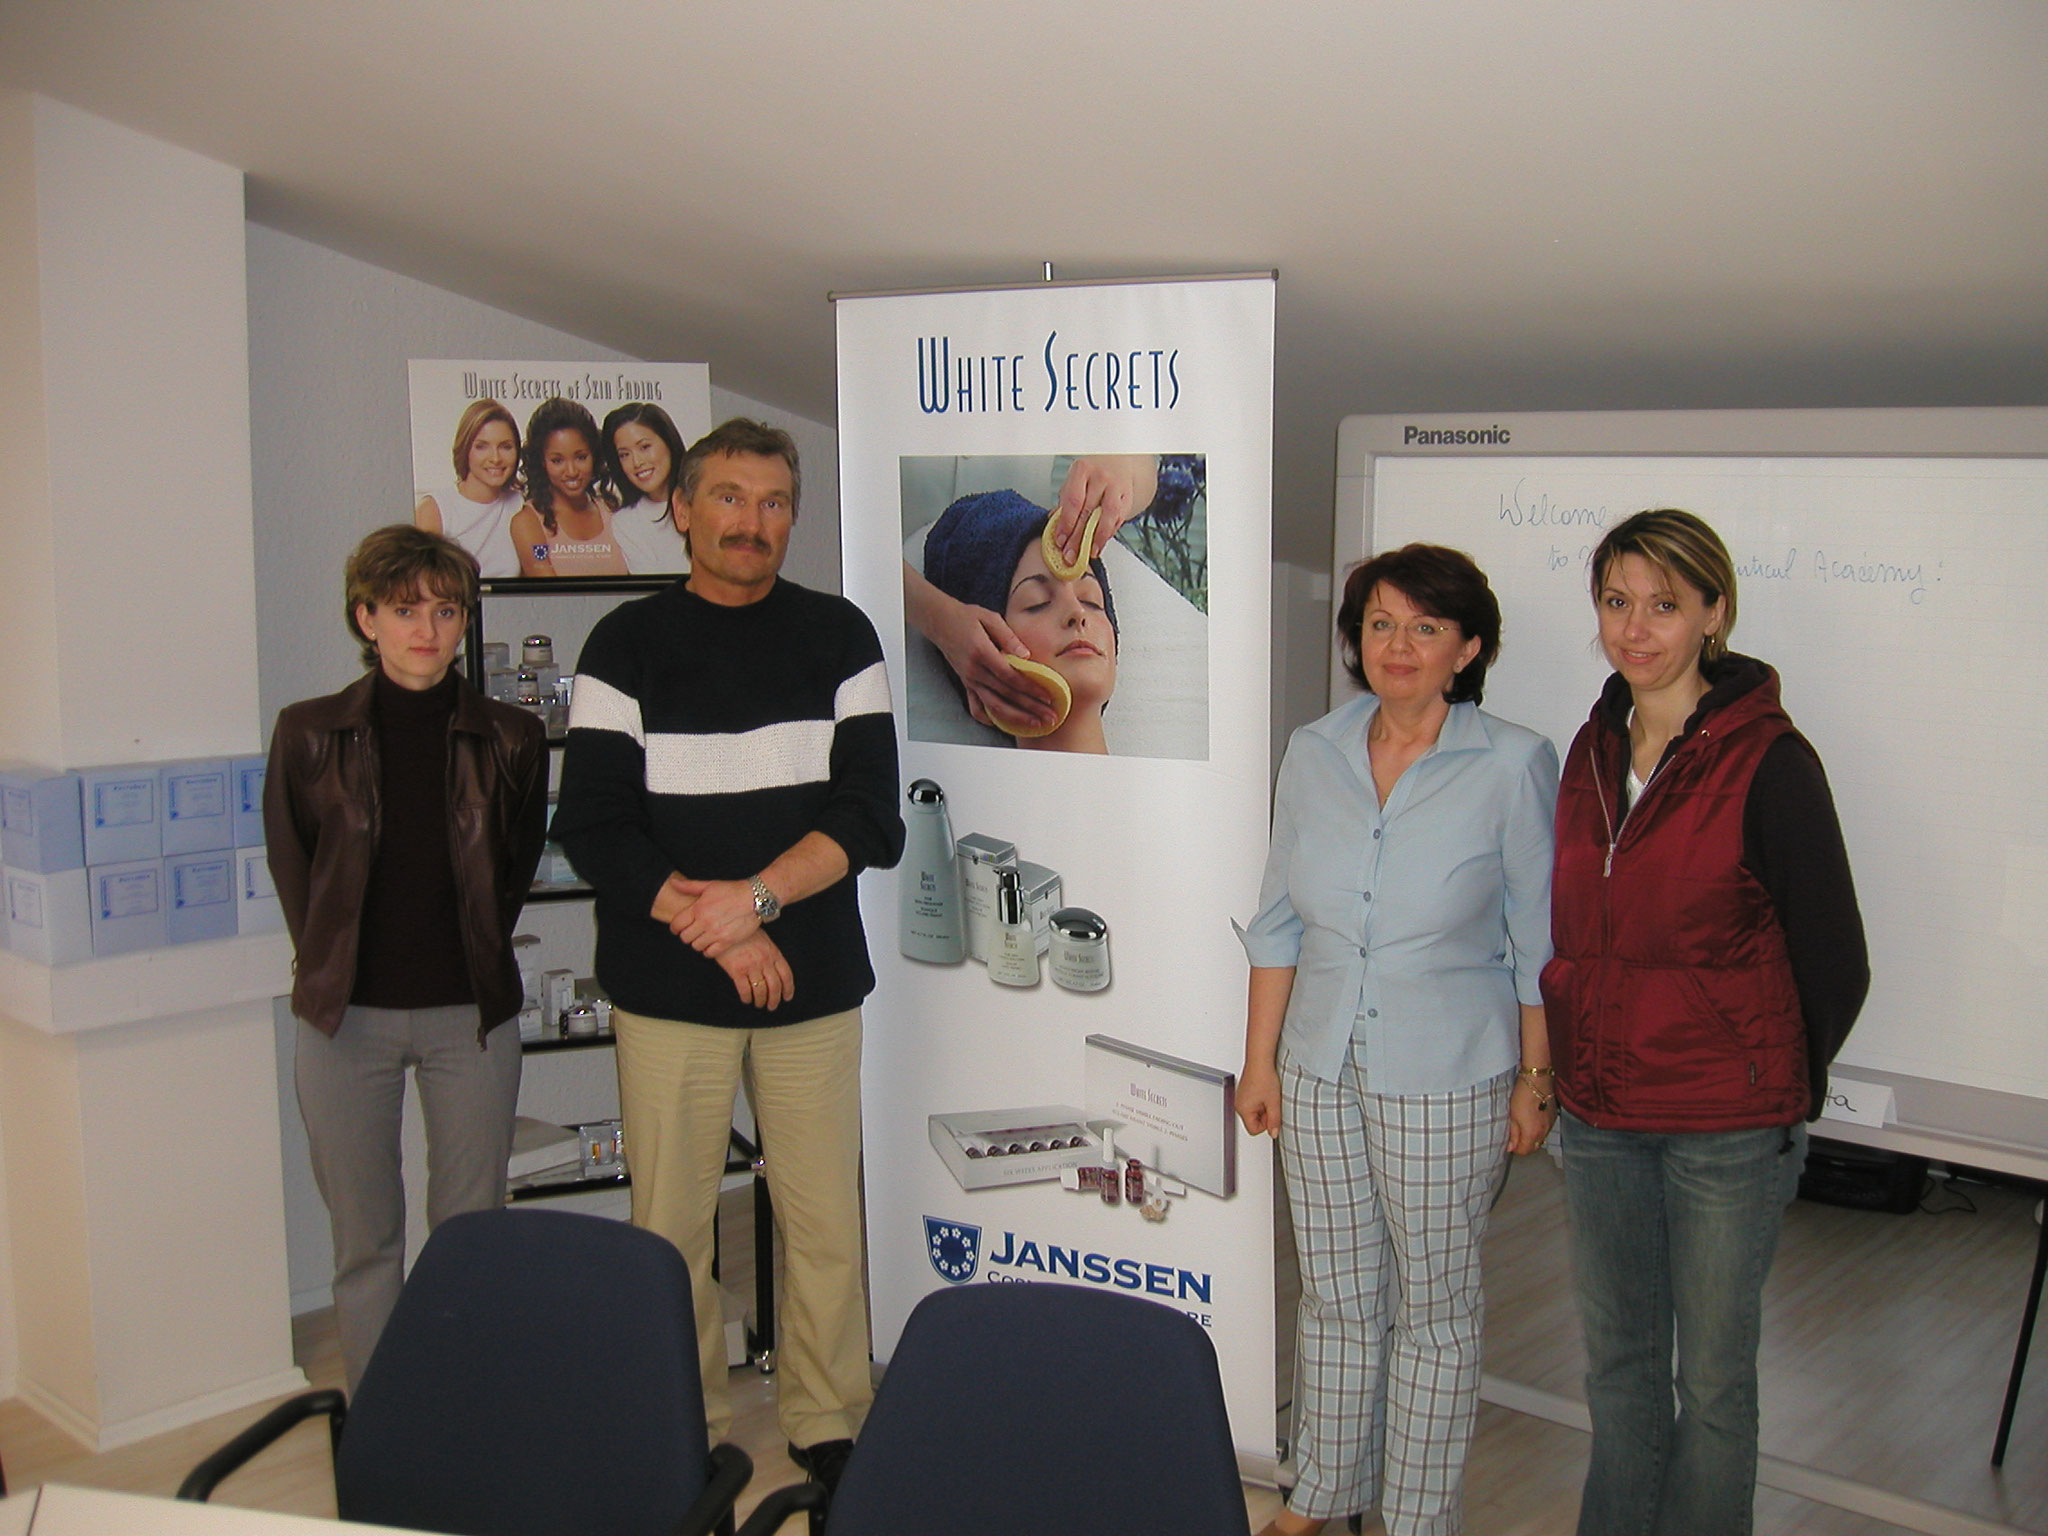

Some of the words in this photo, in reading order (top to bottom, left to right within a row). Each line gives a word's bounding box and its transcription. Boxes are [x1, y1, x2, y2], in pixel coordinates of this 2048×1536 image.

[917, 335, 1025, 414] WHITE
[1044, 330, 1180, 412] SECRETS
[1404, 424, 1511, 445] Panasonic
[1500, 477, 1607, 529] Welcome
[551, 543, 612, 554] JANSSEN
[1547, 544, 1569, 571] to
[1826, 1086, 1857, 1112] ta
[989, 1231, 1212, 1305] JANSSEN
